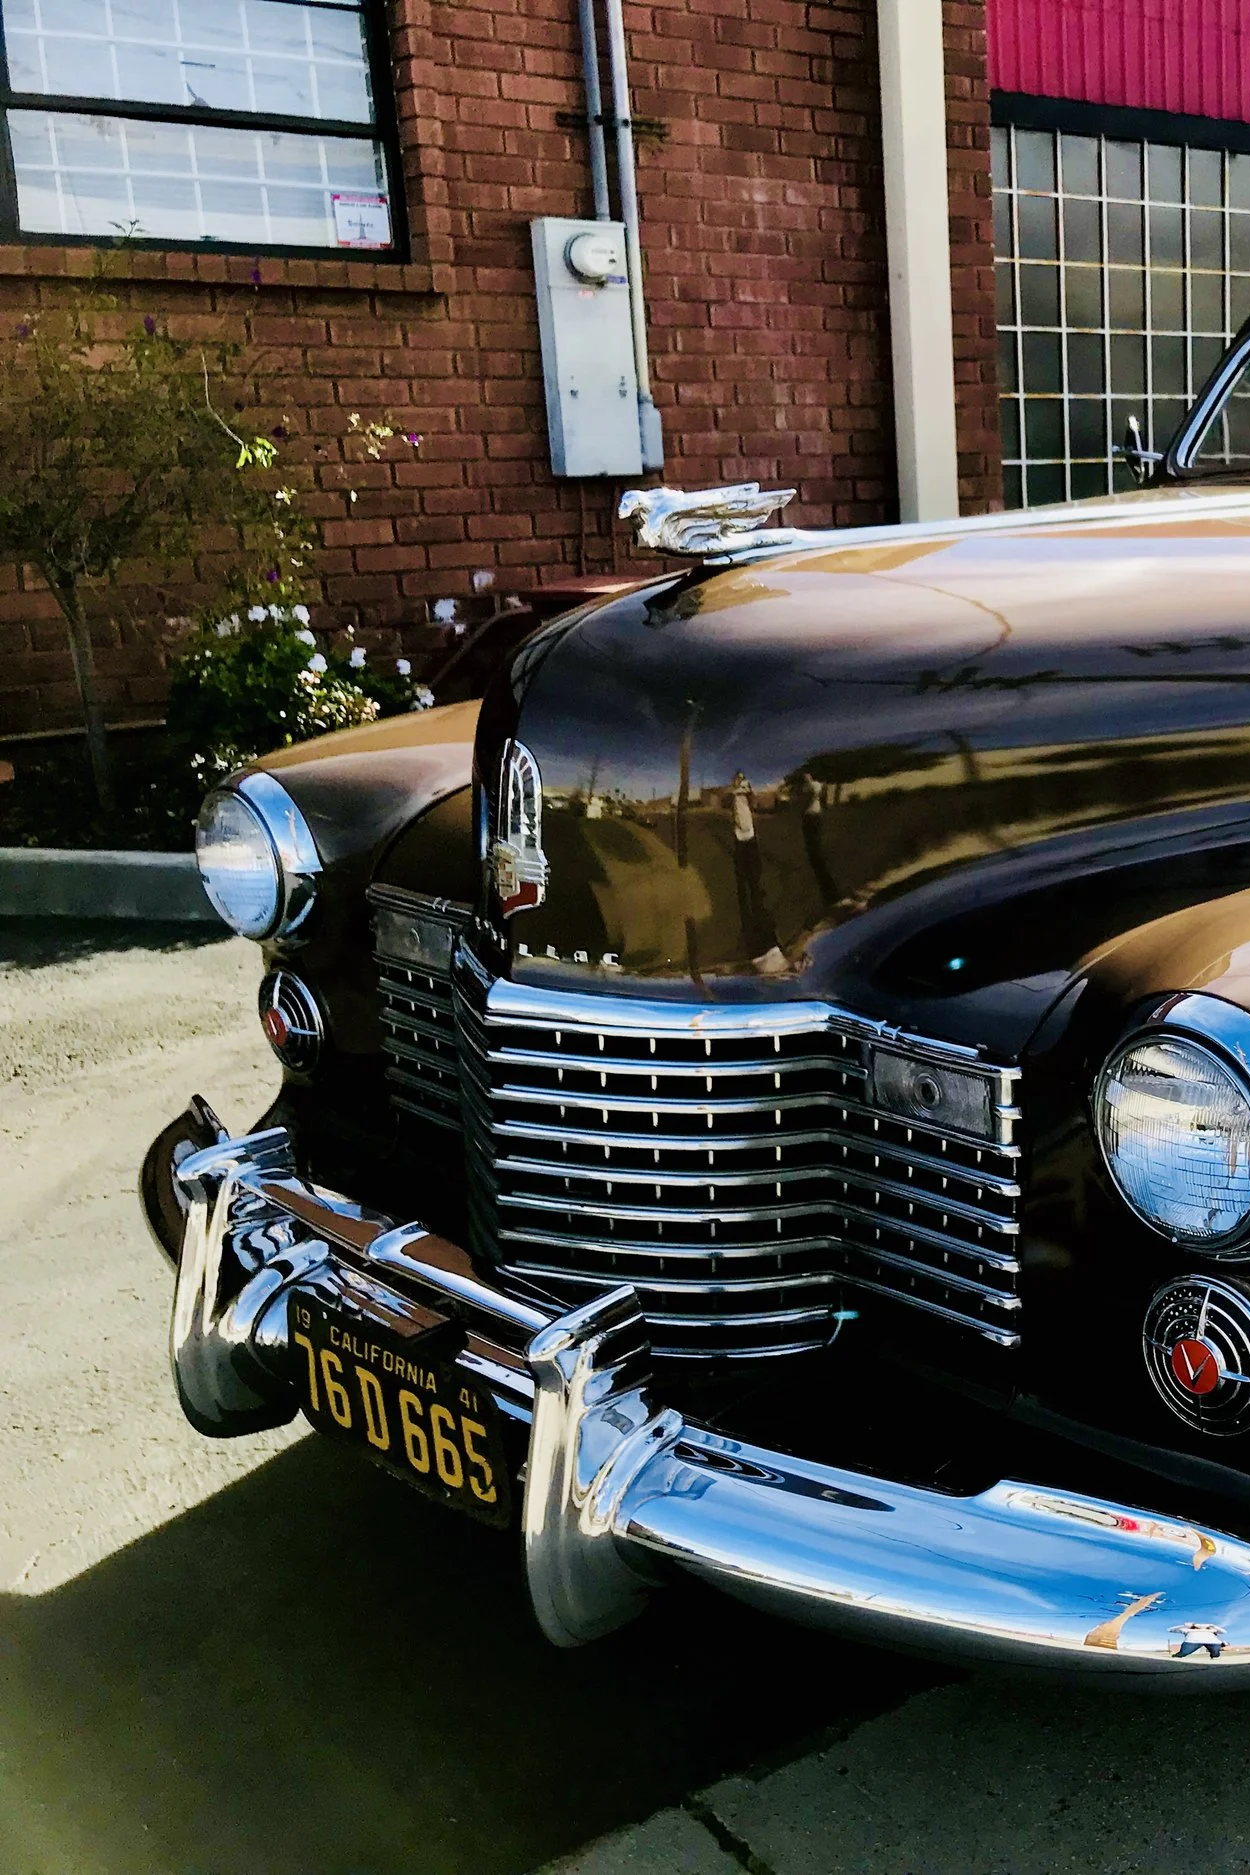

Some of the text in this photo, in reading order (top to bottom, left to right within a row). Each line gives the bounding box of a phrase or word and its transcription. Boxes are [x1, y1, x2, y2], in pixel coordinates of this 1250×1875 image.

[296, 1304, 479, 1413] 19 CALIFORNIA 41
